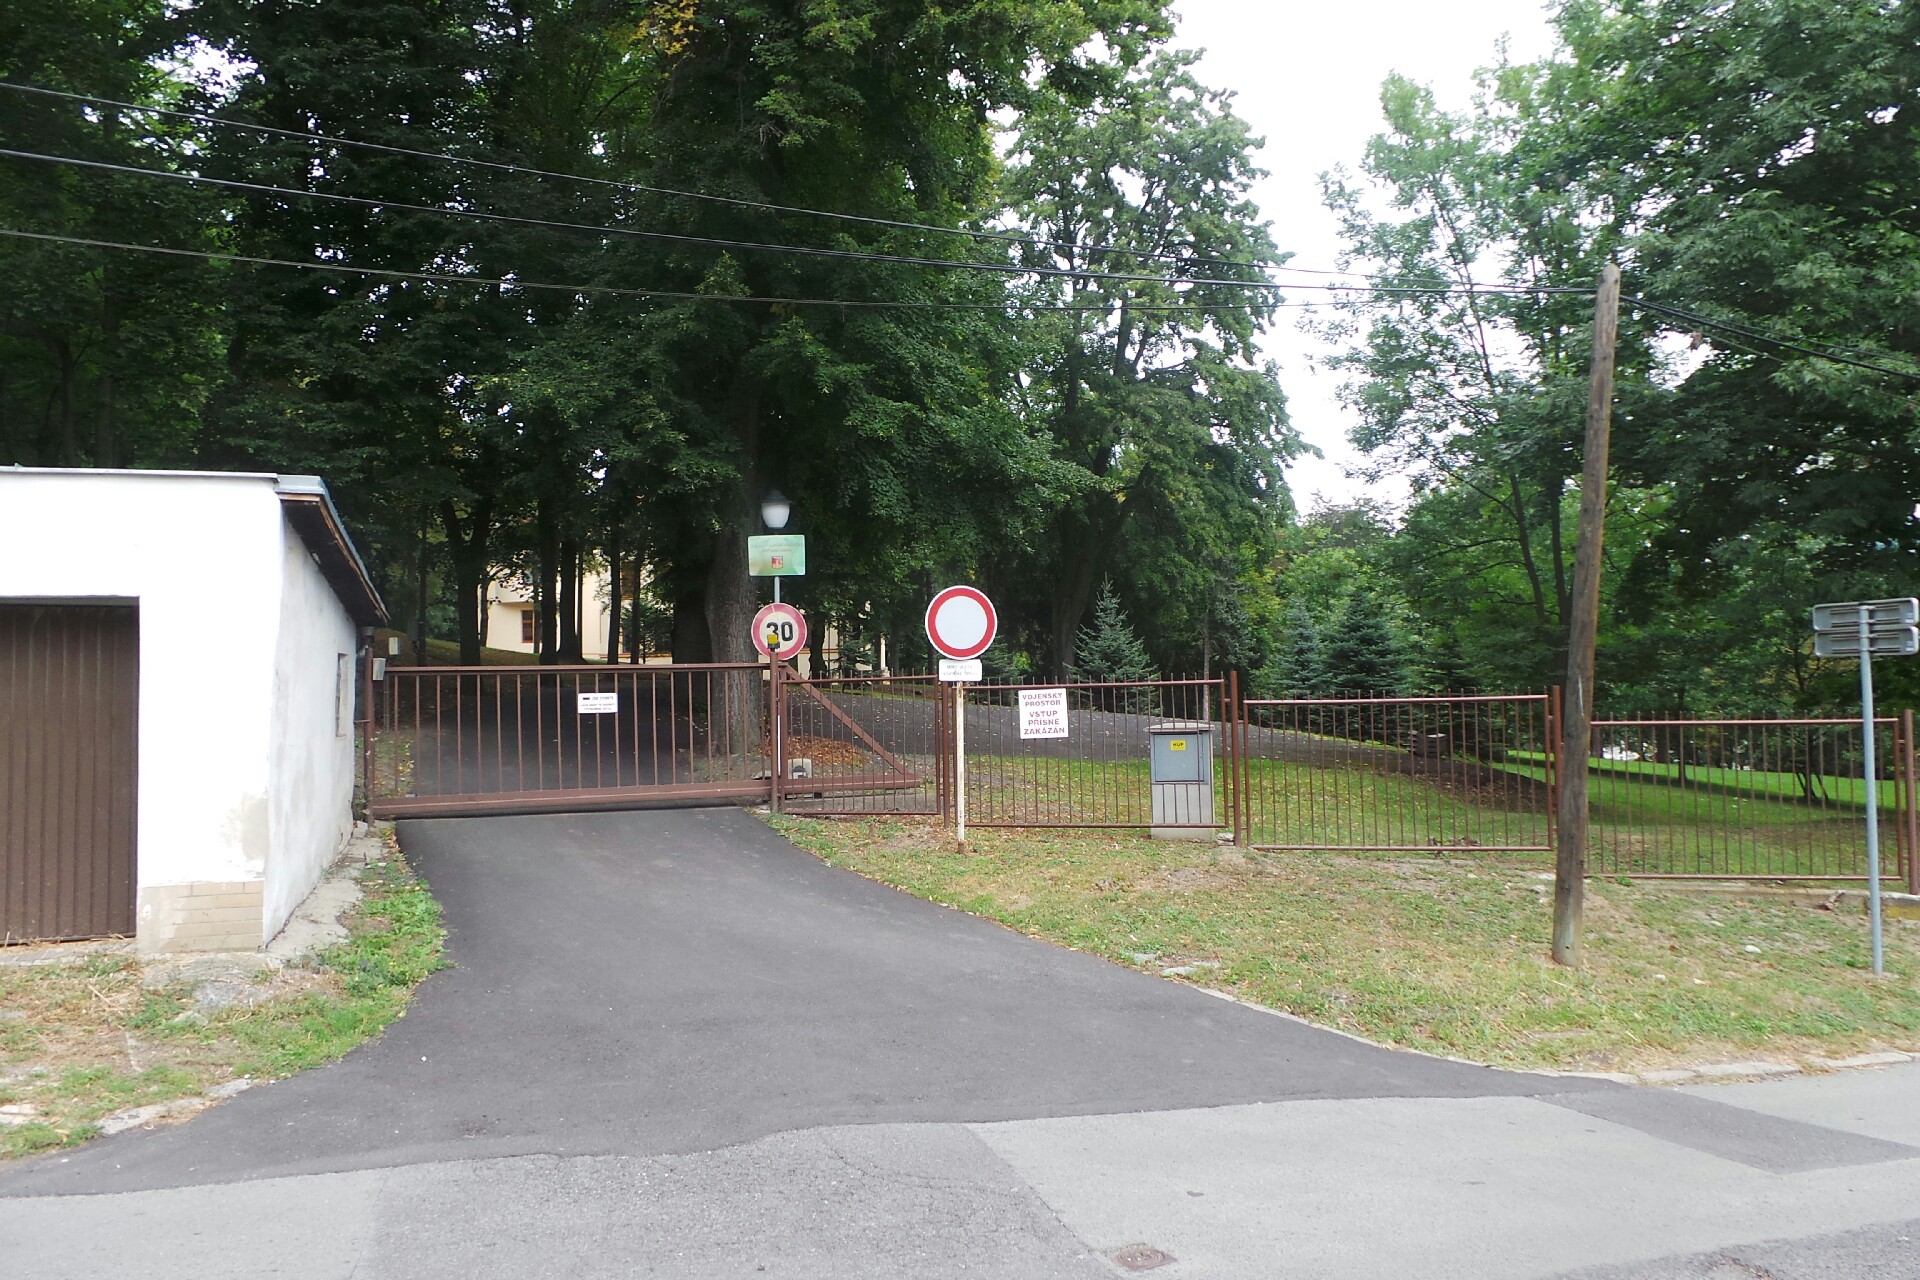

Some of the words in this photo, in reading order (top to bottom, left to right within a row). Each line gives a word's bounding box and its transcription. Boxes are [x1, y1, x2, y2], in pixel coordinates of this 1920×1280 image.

[766, 621, 794, 642] 30
[1025, 699, 1061, 707] PROSTOR
[1029, 710, 1058, 718] VSTUP
